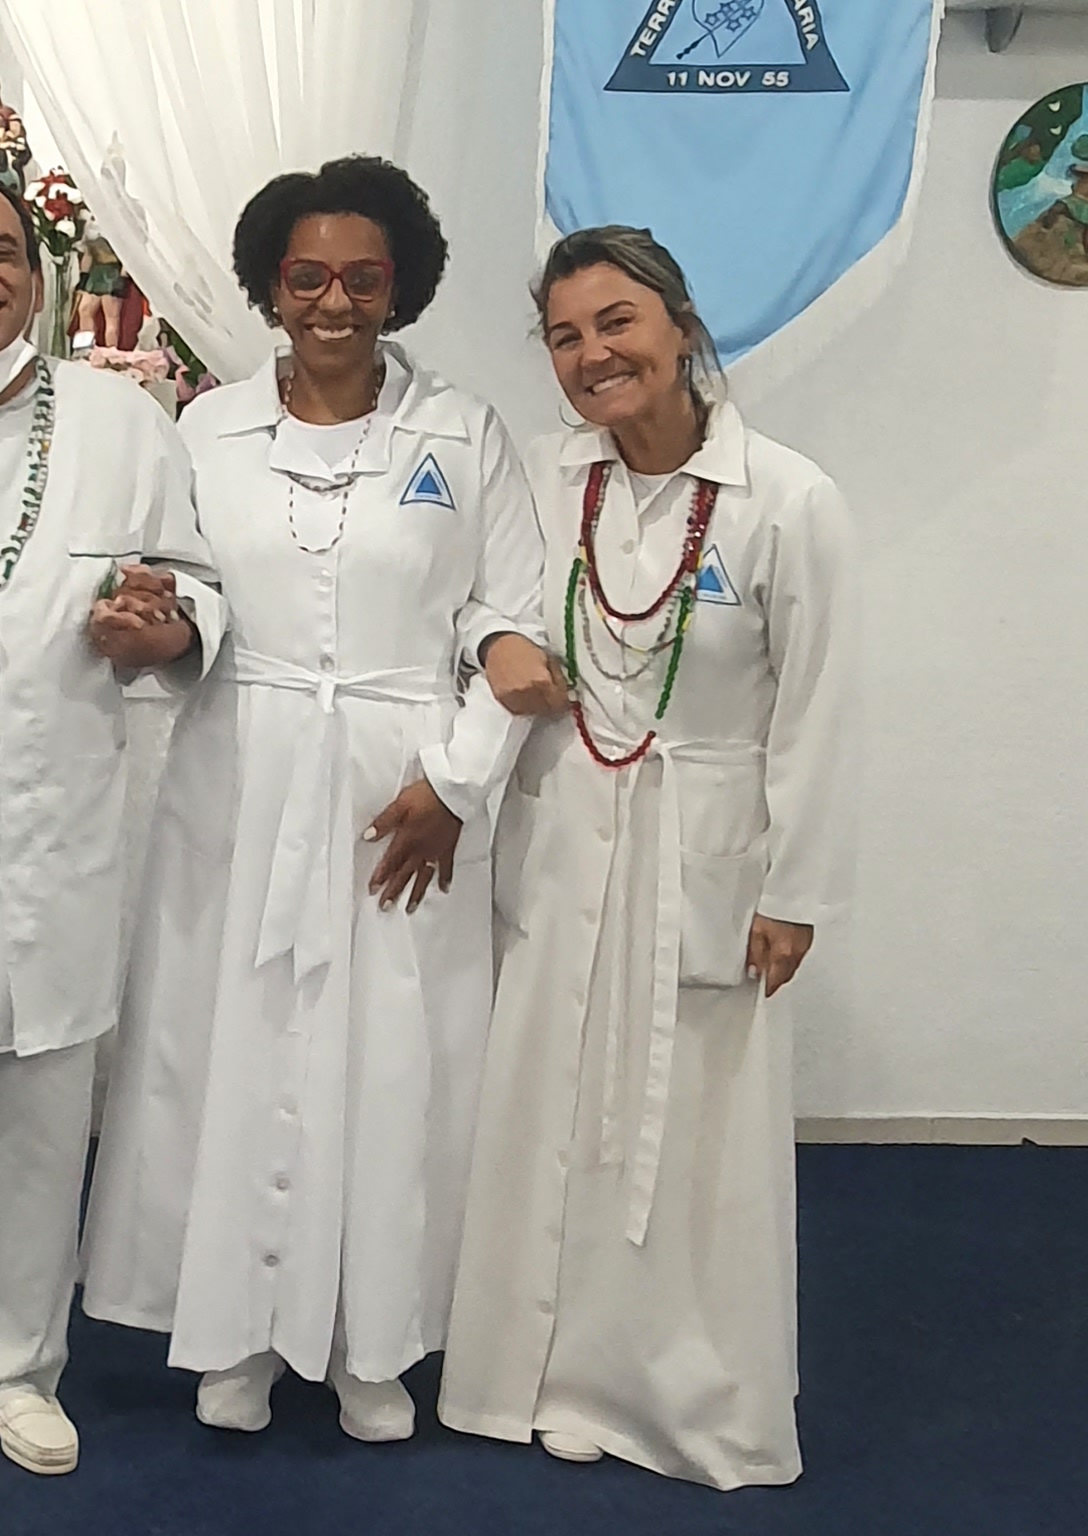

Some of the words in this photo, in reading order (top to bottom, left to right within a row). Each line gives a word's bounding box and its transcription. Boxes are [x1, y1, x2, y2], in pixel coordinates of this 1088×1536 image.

[666, 70, 688, 86] 11
[698, 70, 751, 86] NOV
[761, 71, 789, 86] 55
